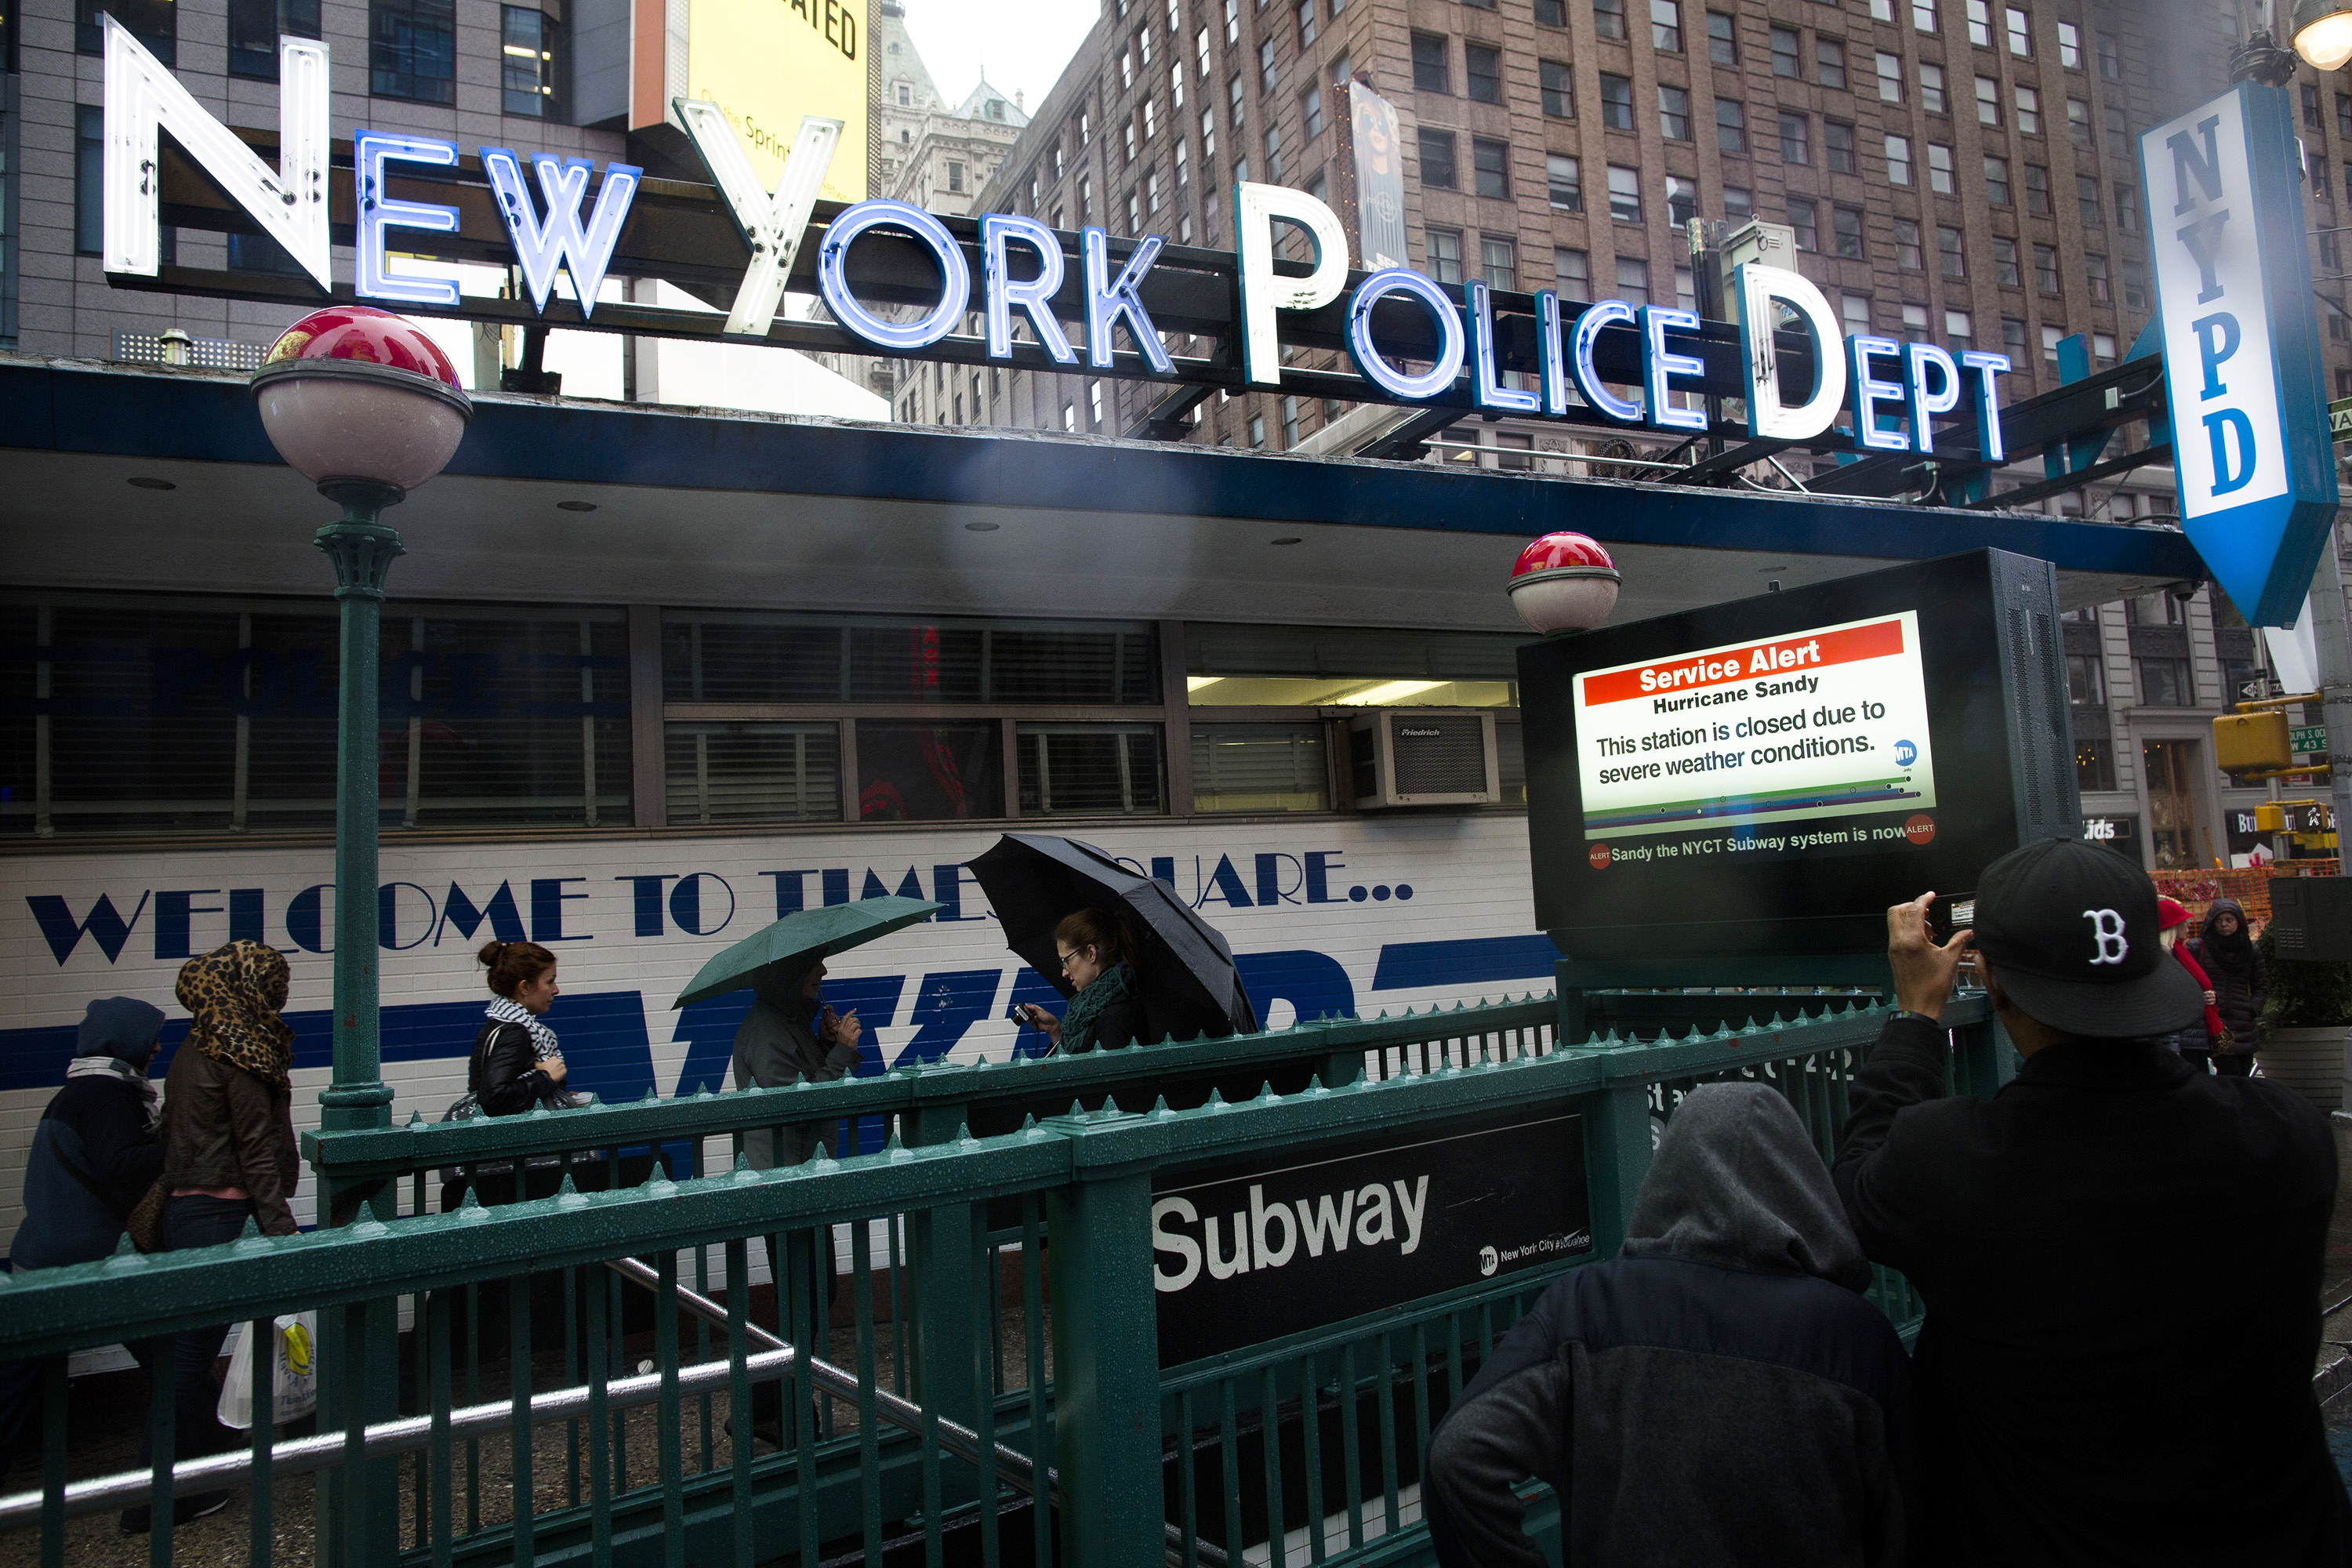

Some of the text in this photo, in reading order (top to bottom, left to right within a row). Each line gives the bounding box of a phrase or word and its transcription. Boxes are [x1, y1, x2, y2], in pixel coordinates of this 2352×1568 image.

[103, 11, 2011, 463] NEW YORK POLICE DEPT
[2166, 114, 2256, 498] NYPD
[147, 647, 500, 717] POLCE
[1639, 640, 1820, 691] Service Alert
[1653, 675, 1819, 714] Hurricane Sandy
[1596, 700, 1886, 757] This station is closed due to
[1893, 746, 1914, 764] MTA
[2303, 740, 2318, 750] 43
[1599, 735, 1875, 785] severe weather conditions.
[1590, 824, 1934, 862] ALERT Sandy the NYCT Subway system is now ALERT
[25, 877, 593, 967] WELCOME
[615, 871, 735, 938] TO
[758, 863, 1001, 923] TIME
[2082, 909, 2129, 965] B
[1151, 1174, 1429, 1293] Subway
[1501, 1249, 1519, 1262] New
[1538, 1240, 1555, 1252] City
